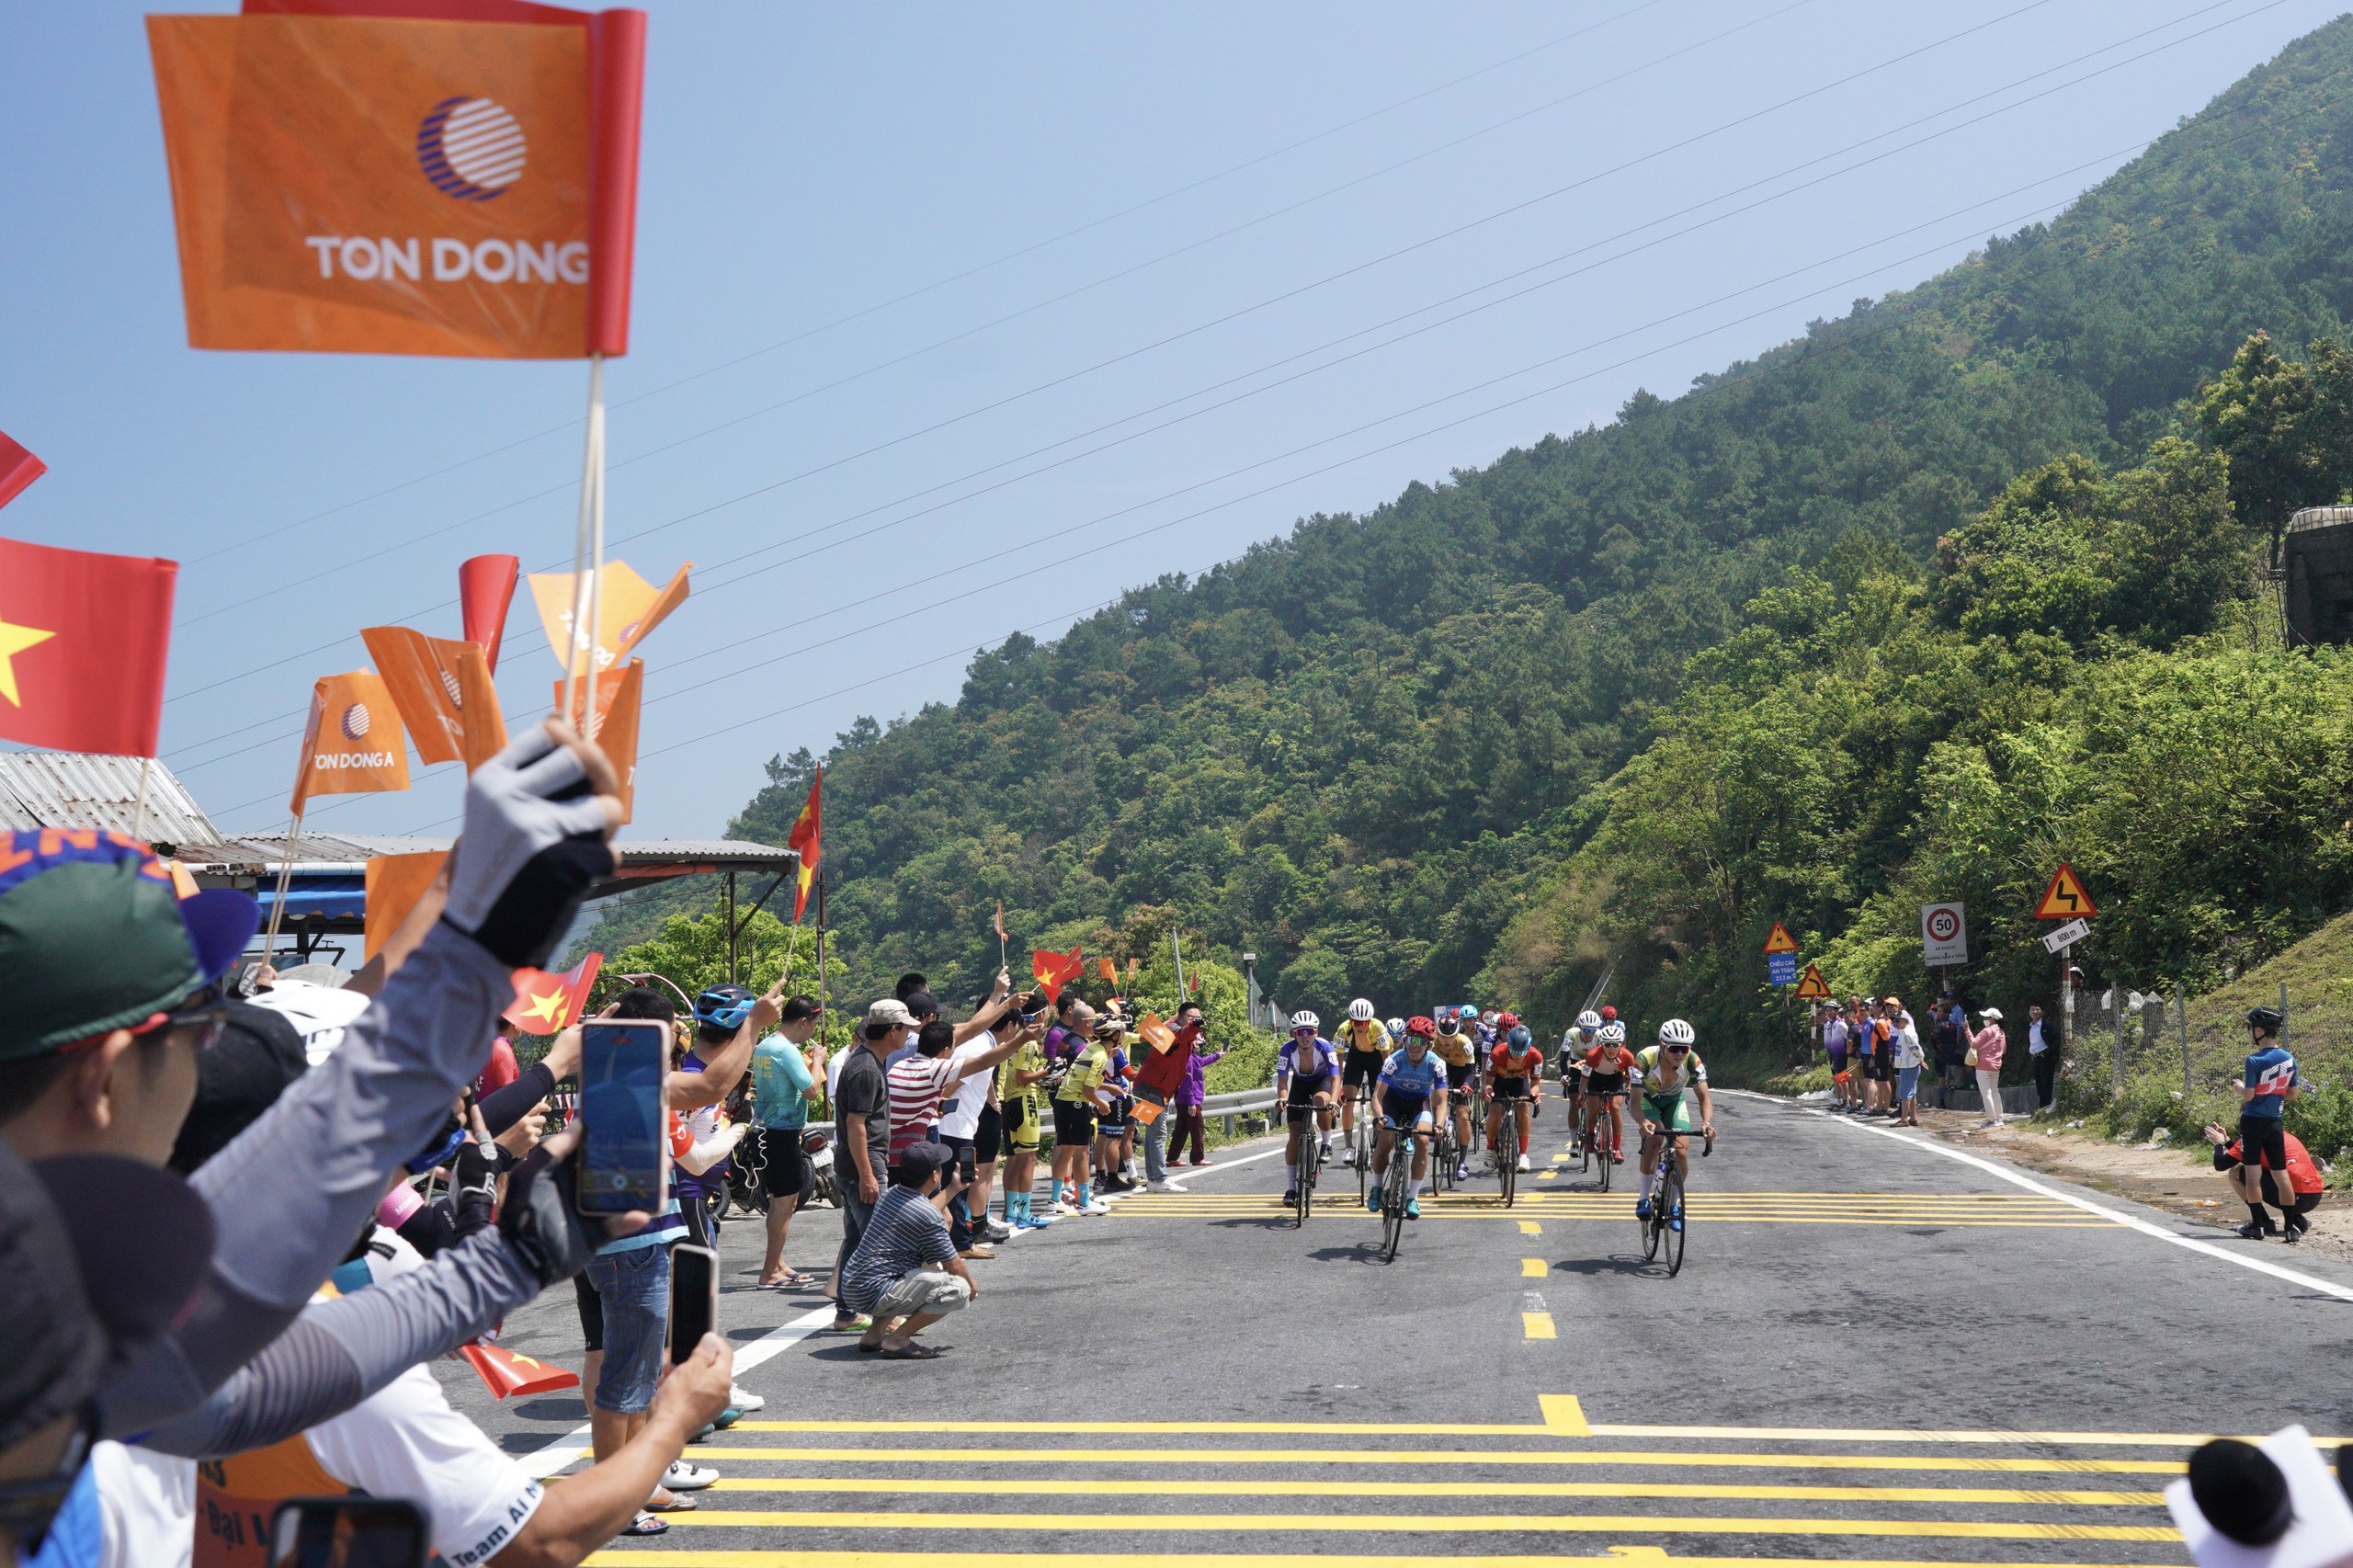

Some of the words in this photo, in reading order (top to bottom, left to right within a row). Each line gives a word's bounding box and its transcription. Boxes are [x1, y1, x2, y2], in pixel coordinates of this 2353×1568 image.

[305, 235, 420, 280] TON
[431, 238, 589, 284] DONG
[314, 754, 338, 770] ON
[1936, 918, 1952, 931] 50
[2057, 931, 2070, 943] 800
[450, 1525, 509, 1567] Team
